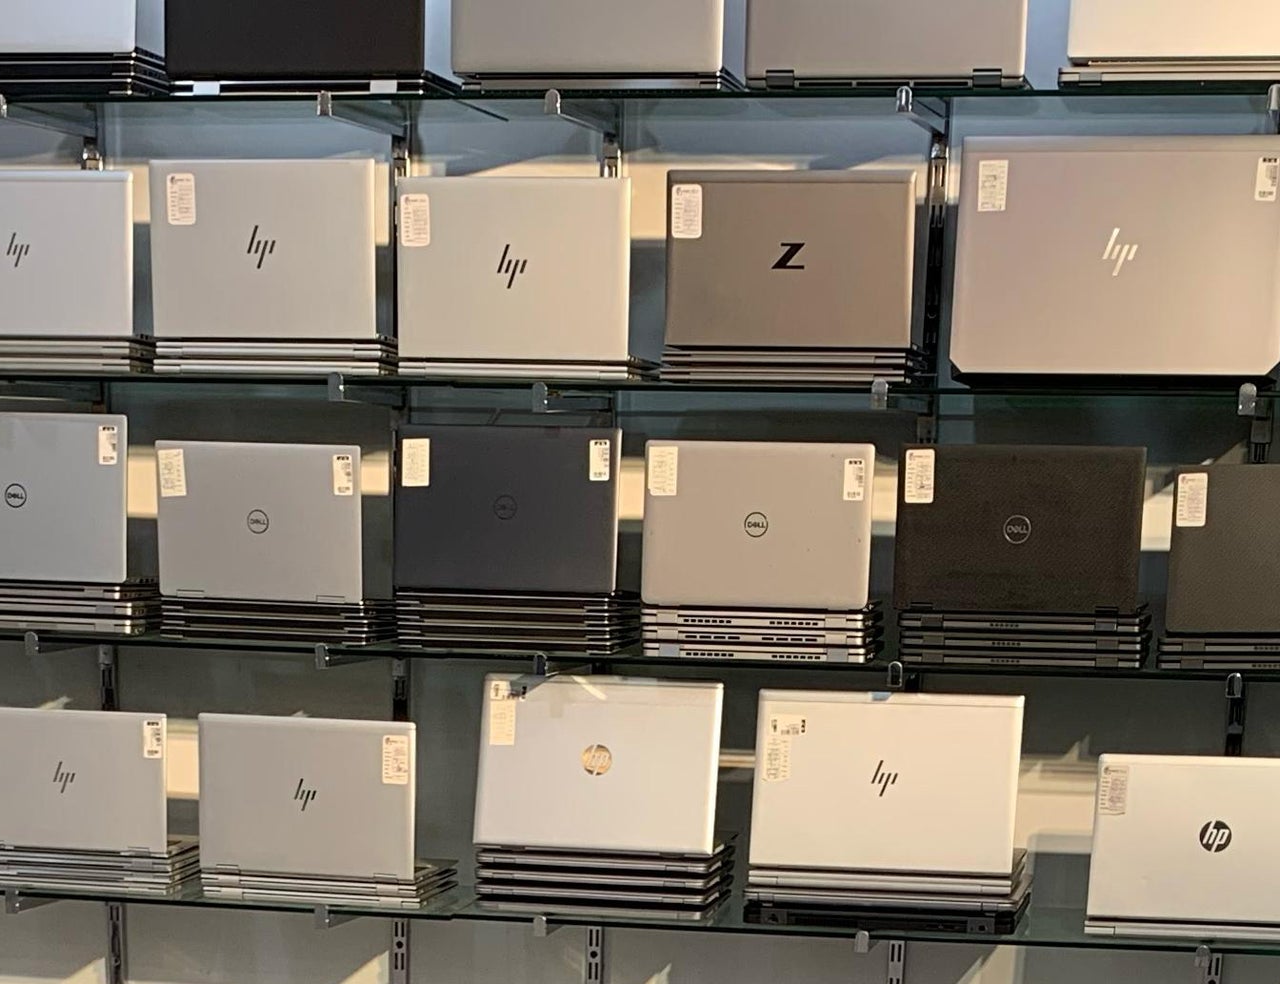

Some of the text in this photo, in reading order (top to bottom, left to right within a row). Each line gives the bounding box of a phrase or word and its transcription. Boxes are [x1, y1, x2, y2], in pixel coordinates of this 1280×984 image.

[6, 232, 30, 268] hp
[247, 225, 276, 270] hp
[771, 242, 806, 270] Z
[1102, 227, 1139, 276] hp
[497, 244, 527, 289] hp
[53, 761, 76, 794] hp
[294, 778, 317, 811] hp
[871, 760, 898, 797] hp
[1201, 820, 1231, 853] hp
